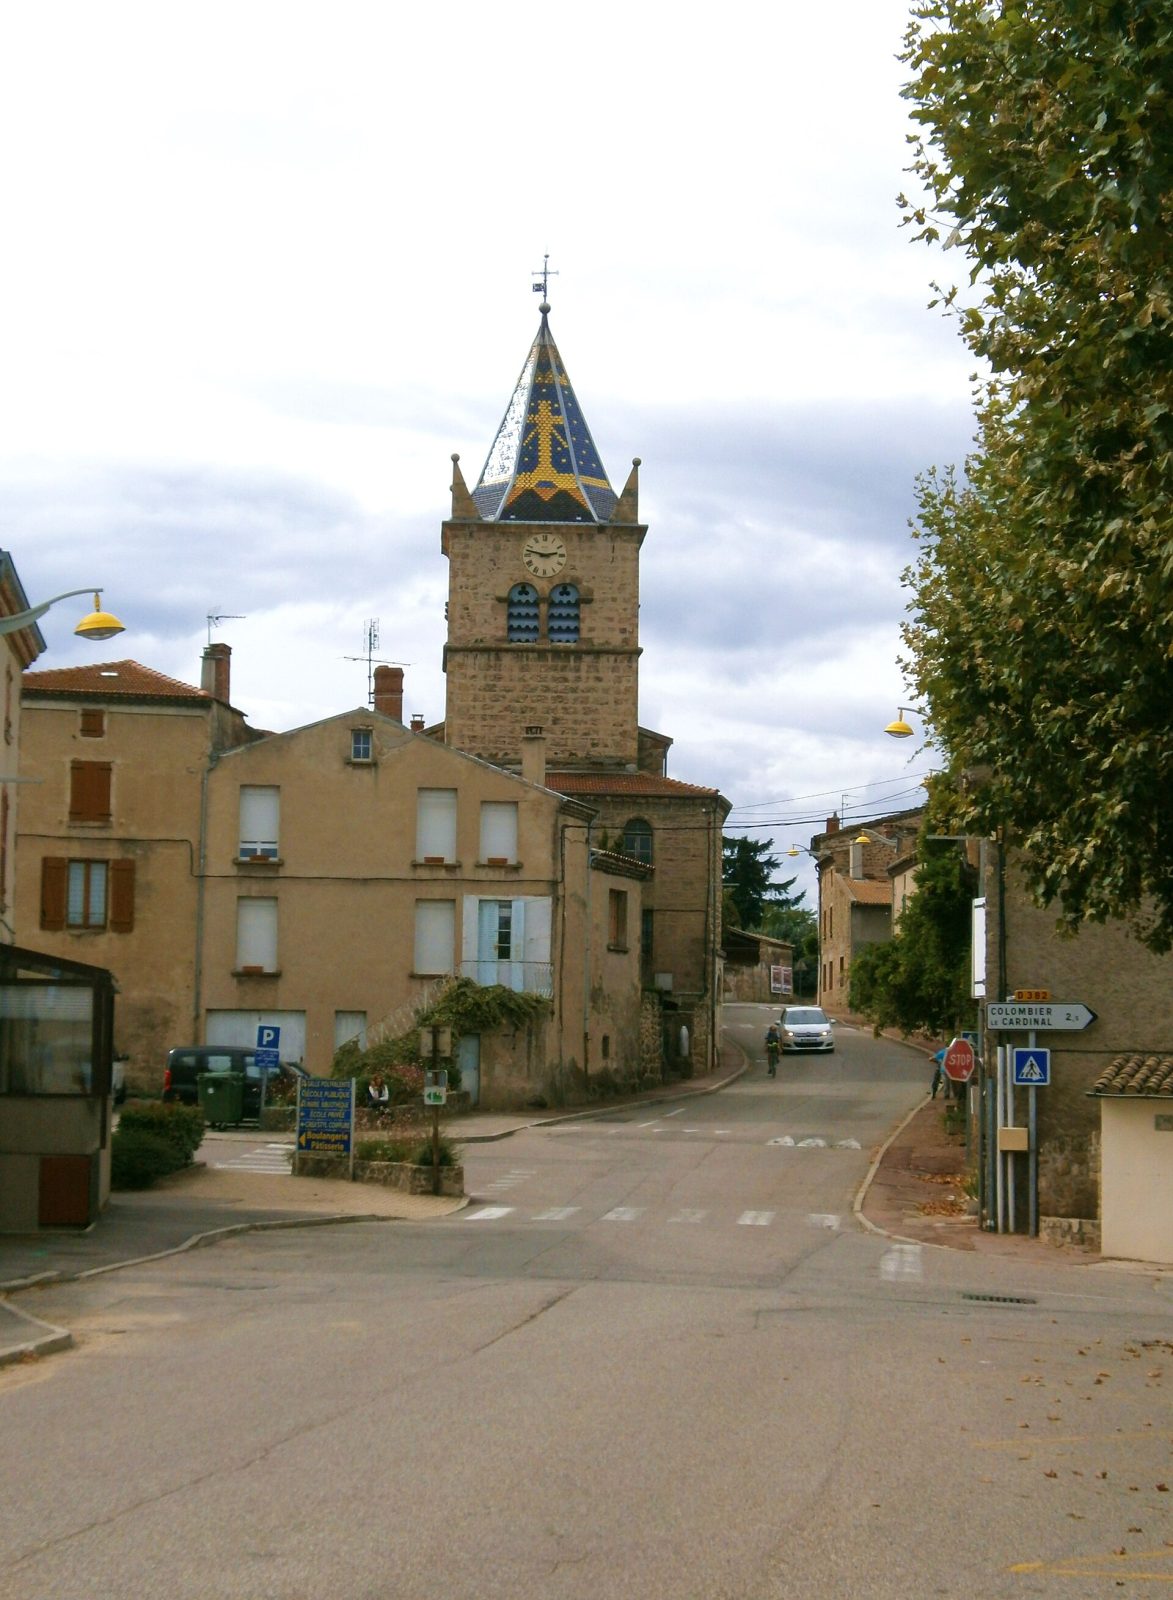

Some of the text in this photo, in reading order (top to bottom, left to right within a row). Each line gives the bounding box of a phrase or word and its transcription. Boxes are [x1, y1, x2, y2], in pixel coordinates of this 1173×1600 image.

[1017, 991, 1048, 1000] D 382
[990, 1007, 1053, 1016] COLOMBIER
[1002, 1017, 1053, 1026] CARDINAL
[262, 1029, 275, 1046] P
[949, 1054, 972, 1066] STOP
[324, 1090, 351, 1099] PUBLIQUE
[306, 1131, 349, 1142] Boulangerie
[311, 1140, 345, 1150] Pâtisserie
